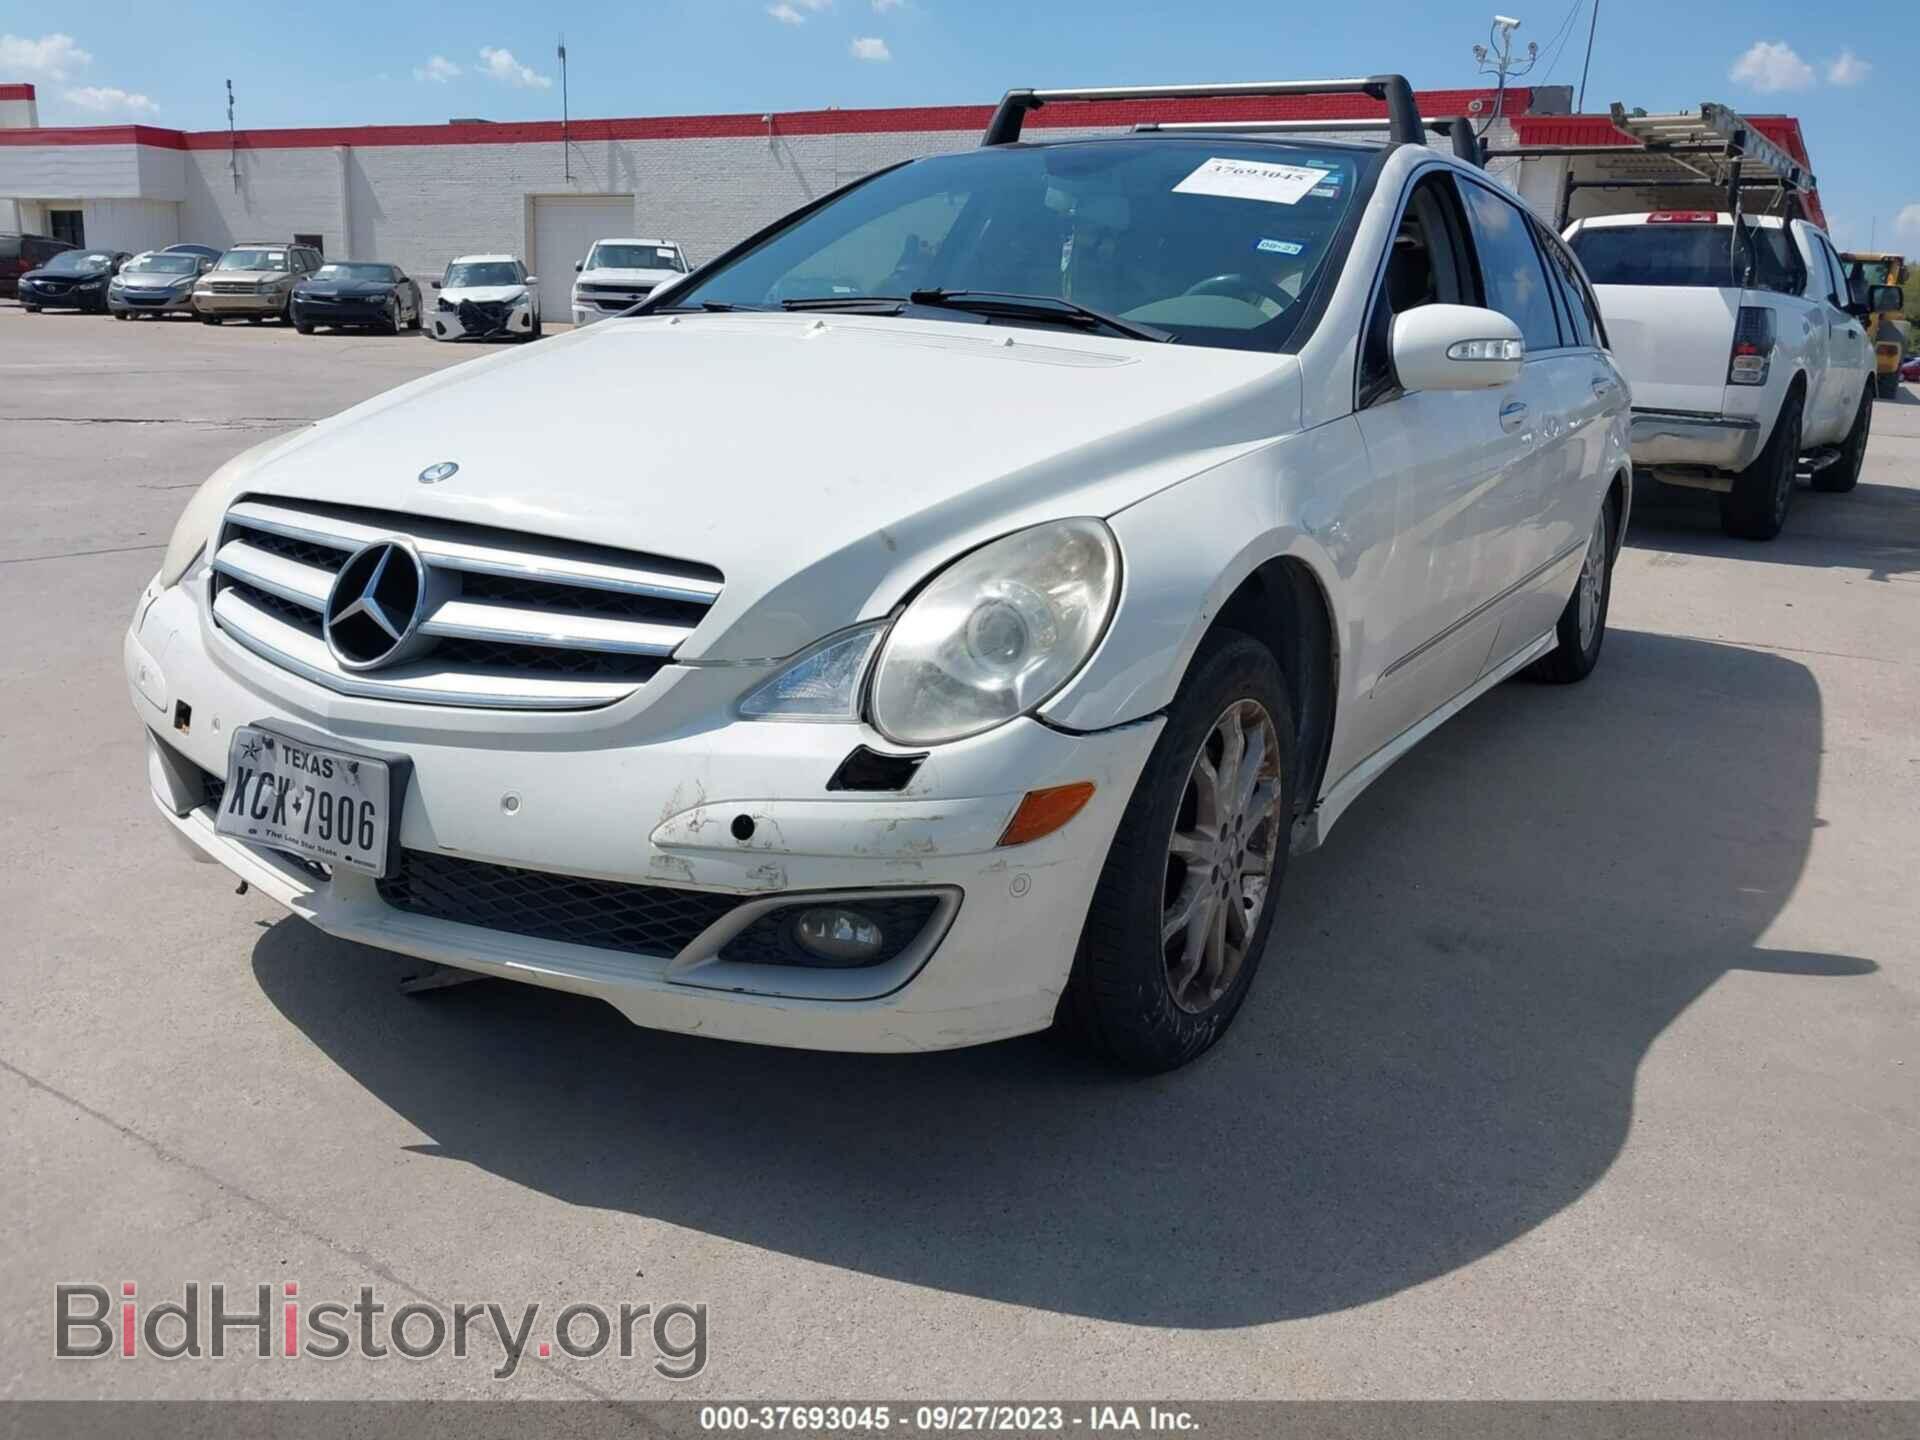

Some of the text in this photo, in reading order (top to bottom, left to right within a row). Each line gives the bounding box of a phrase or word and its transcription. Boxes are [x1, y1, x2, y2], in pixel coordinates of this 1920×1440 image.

[282, 746, 334, 778] TEXAS
[265, 829, 284, 839] The
[301, 840, 316, 850] Star
[316, 845, 338, 857] State
